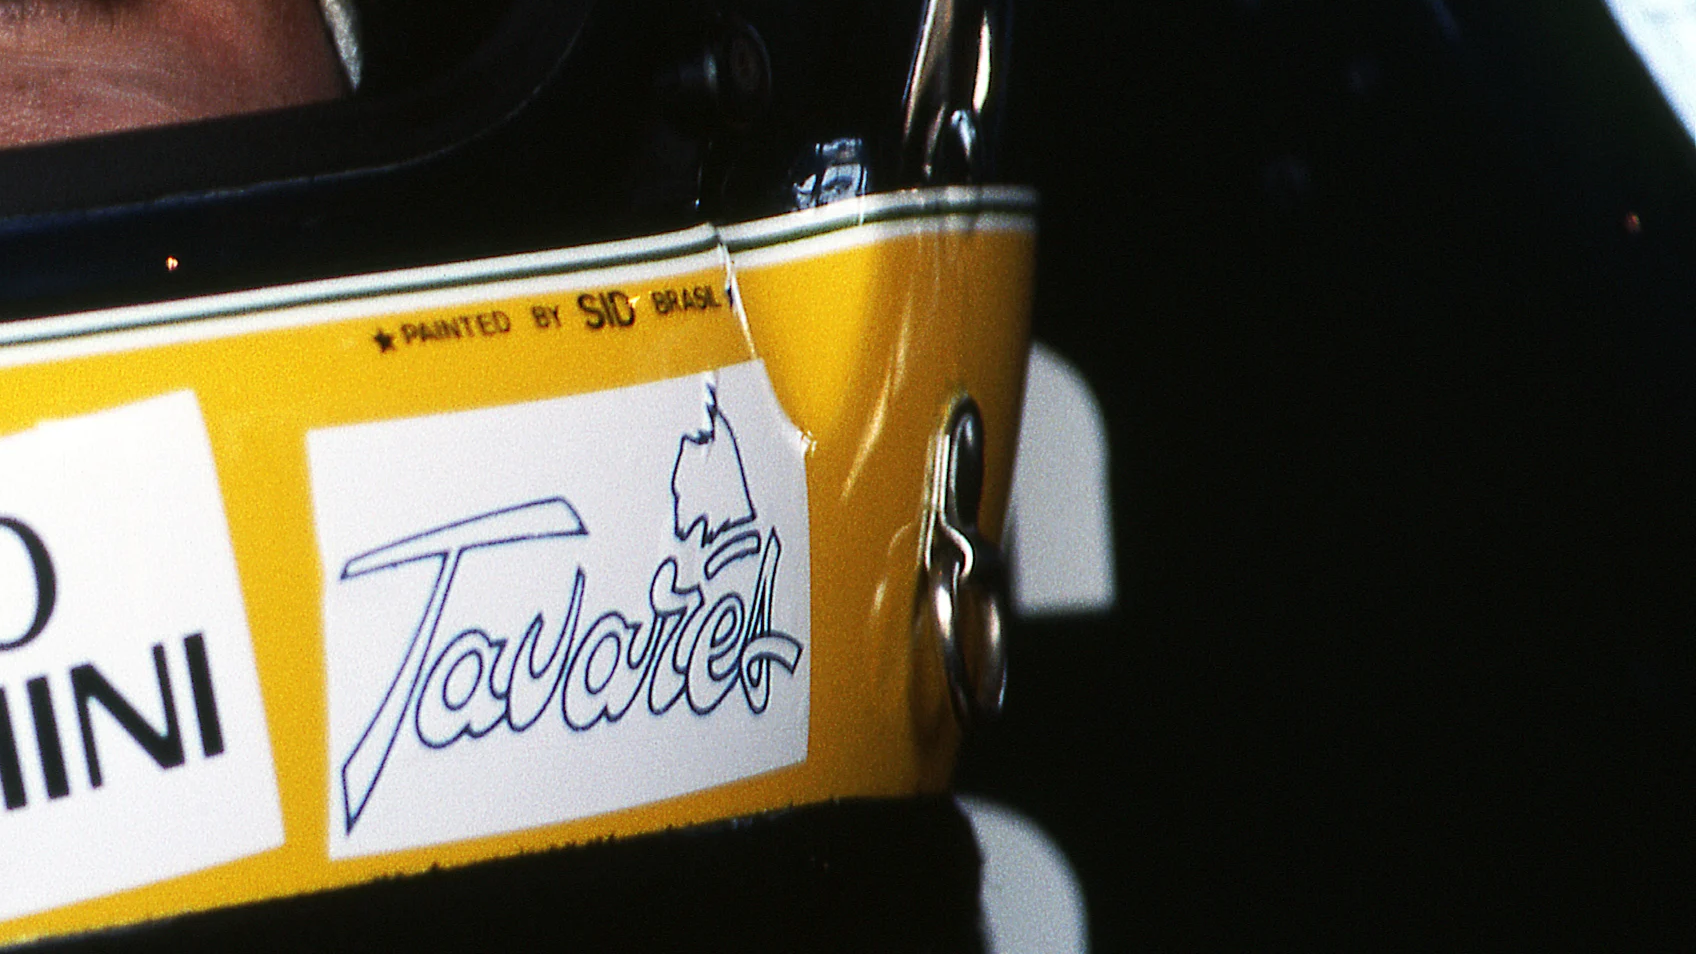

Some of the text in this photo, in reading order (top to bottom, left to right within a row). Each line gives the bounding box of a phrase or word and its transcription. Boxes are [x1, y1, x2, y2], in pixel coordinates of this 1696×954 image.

[400, 284, 722, 345] PAINTED BY SID BRASIL
